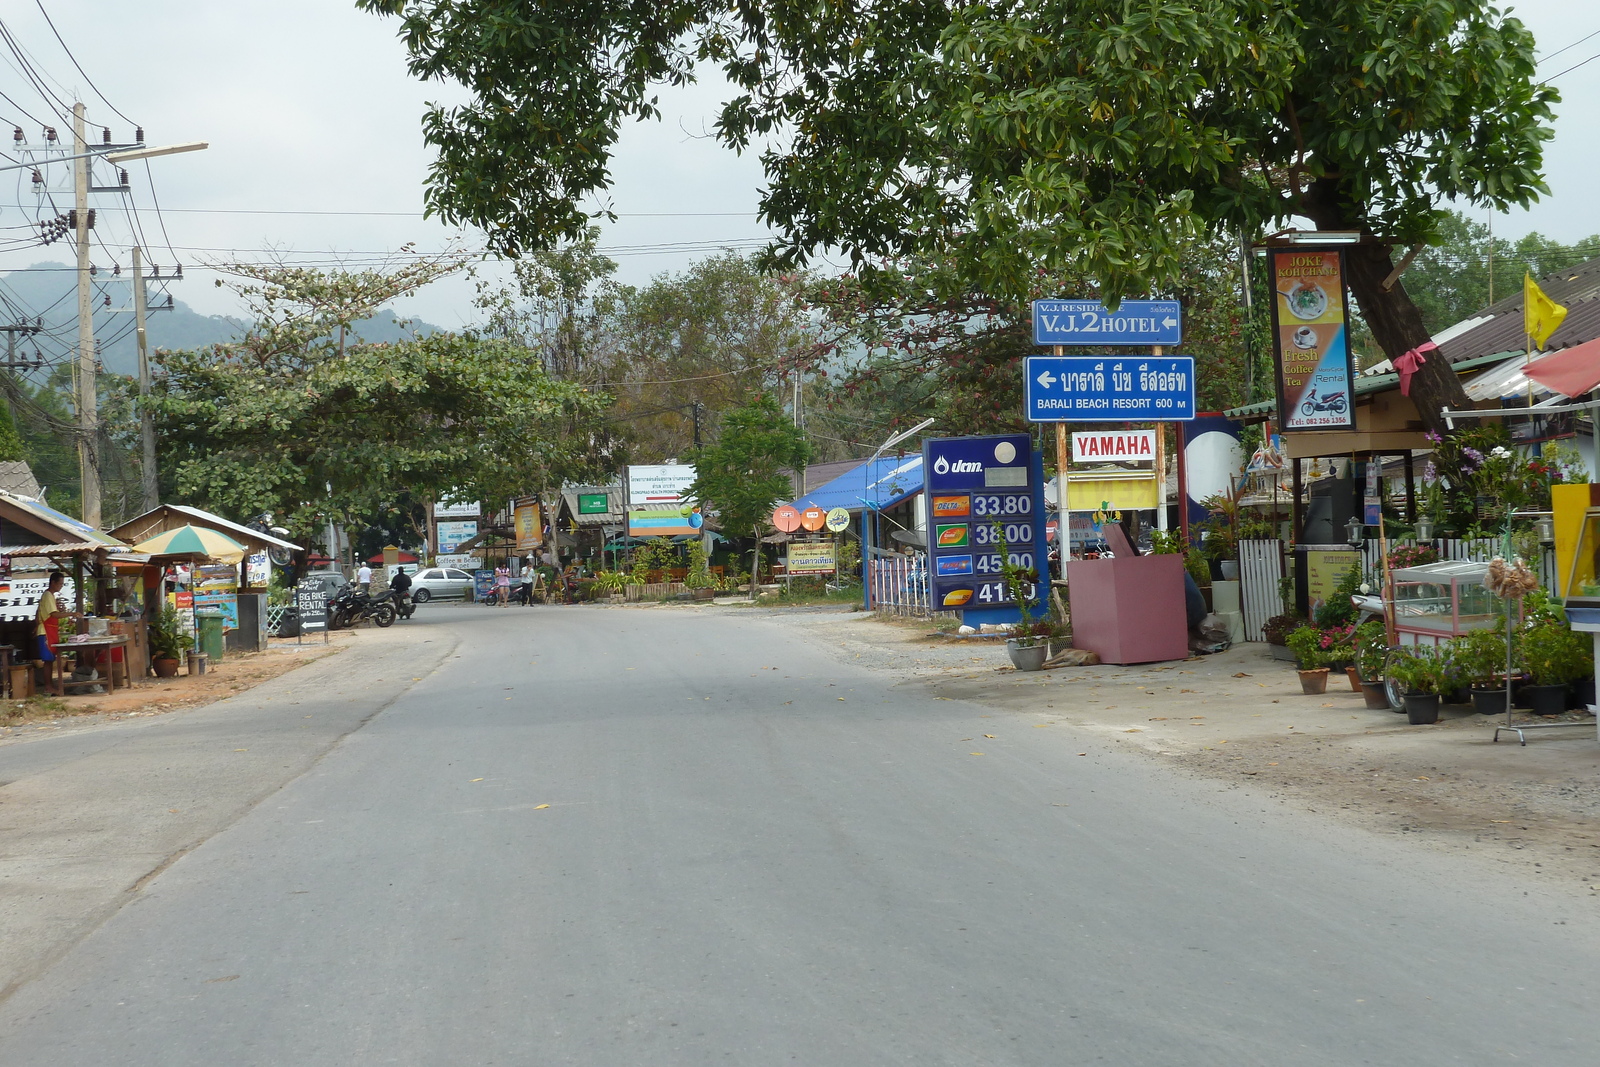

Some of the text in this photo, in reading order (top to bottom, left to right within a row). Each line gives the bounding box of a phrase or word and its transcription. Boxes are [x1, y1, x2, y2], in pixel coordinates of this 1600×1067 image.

[1290, 256, 1324, 267] JOKE
[1278, 266, 1338, 278] KOH CHANG
[1062, 304, 1124, 312] RESIDENE
[1101, 317, 1160, 333] HOTEL
[1283, 349, 1319, 363] Fresh
[1283, 364, 1313, 375] Coffee
[1060, 362, 1186, 392] บาราลี บีช รีสอร์ท
[1285, 377, 1302, 387] Tea
[1316, 374, 1346, 383] Rental
[1037, 399, 1072, 409] BARALI
[1076, 399, 1109, 409] BEACH
[1113, 399, 1151, 409] RESORT
[1155, 398, 1172, 408] 600
[1290, 418, 1304, 426] Tel:
[1077, 435, 1151, 456] YAMAHA
[974, 495, 1031, 516] 33.80
[975, 523, 1032, 545] 3800
[976, 553, 1034, 576] 4500
[15, 582, 39, 590] BIG
[299, 591, 327, 601] BIG BIKE
[299, 601, 327, 610] RENTAL
